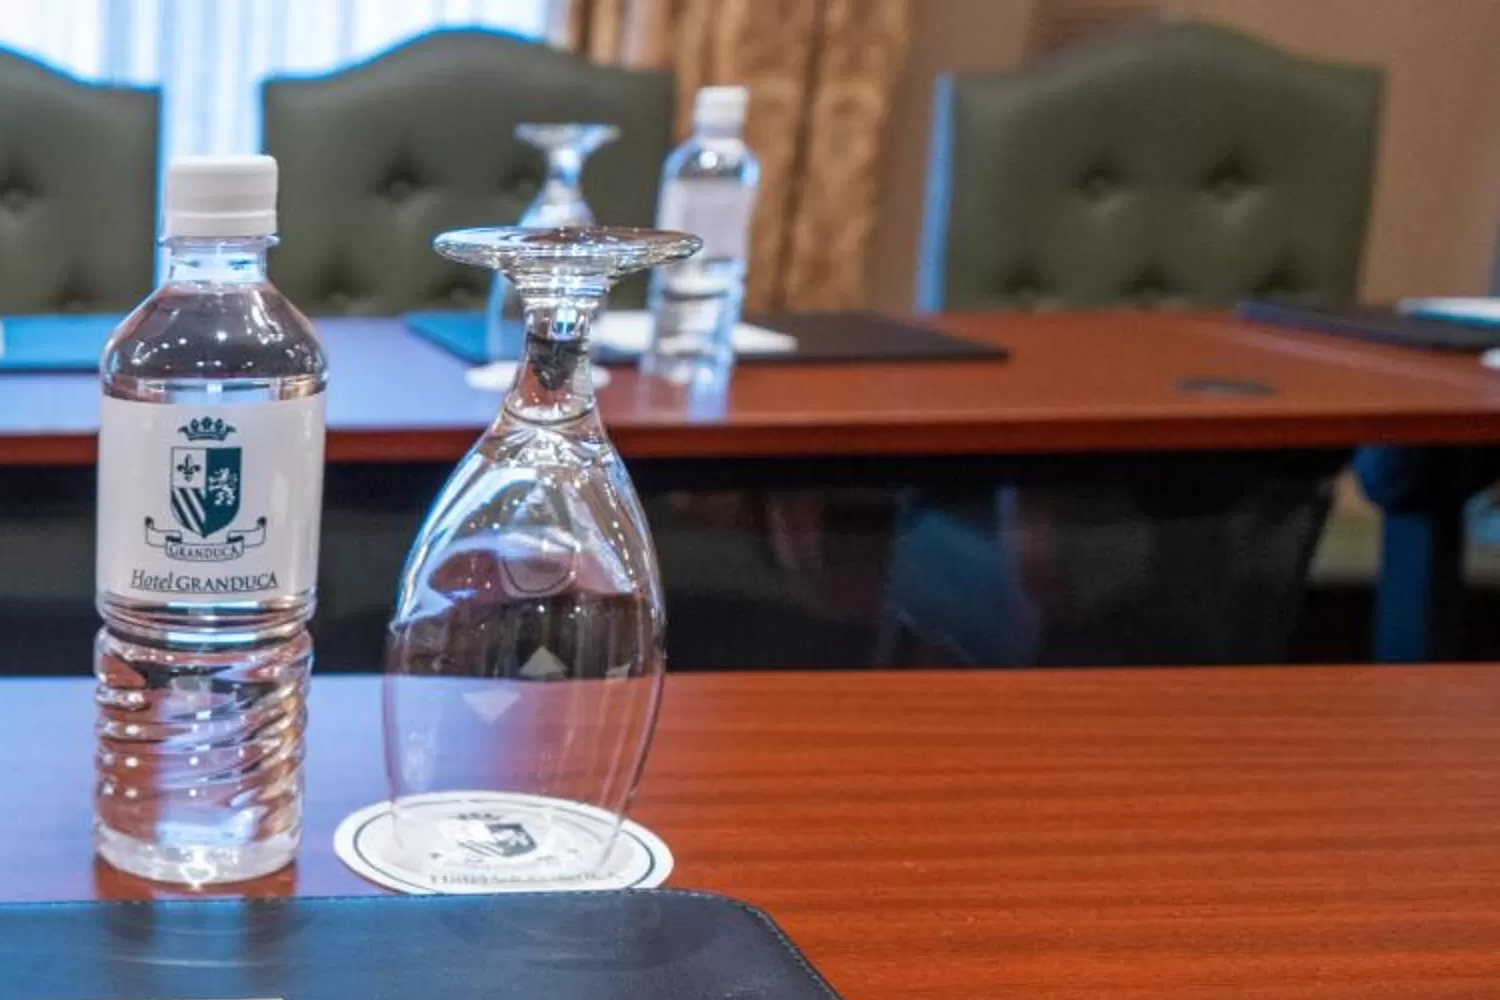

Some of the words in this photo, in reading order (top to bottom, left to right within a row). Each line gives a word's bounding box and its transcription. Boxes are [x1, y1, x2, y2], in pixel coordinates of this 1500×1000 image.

[168, 543, 238, 557] GRANDUCA
[130, 568, 174, 590] Hotel
[176, 571, 279, 592] GRANDUCA
